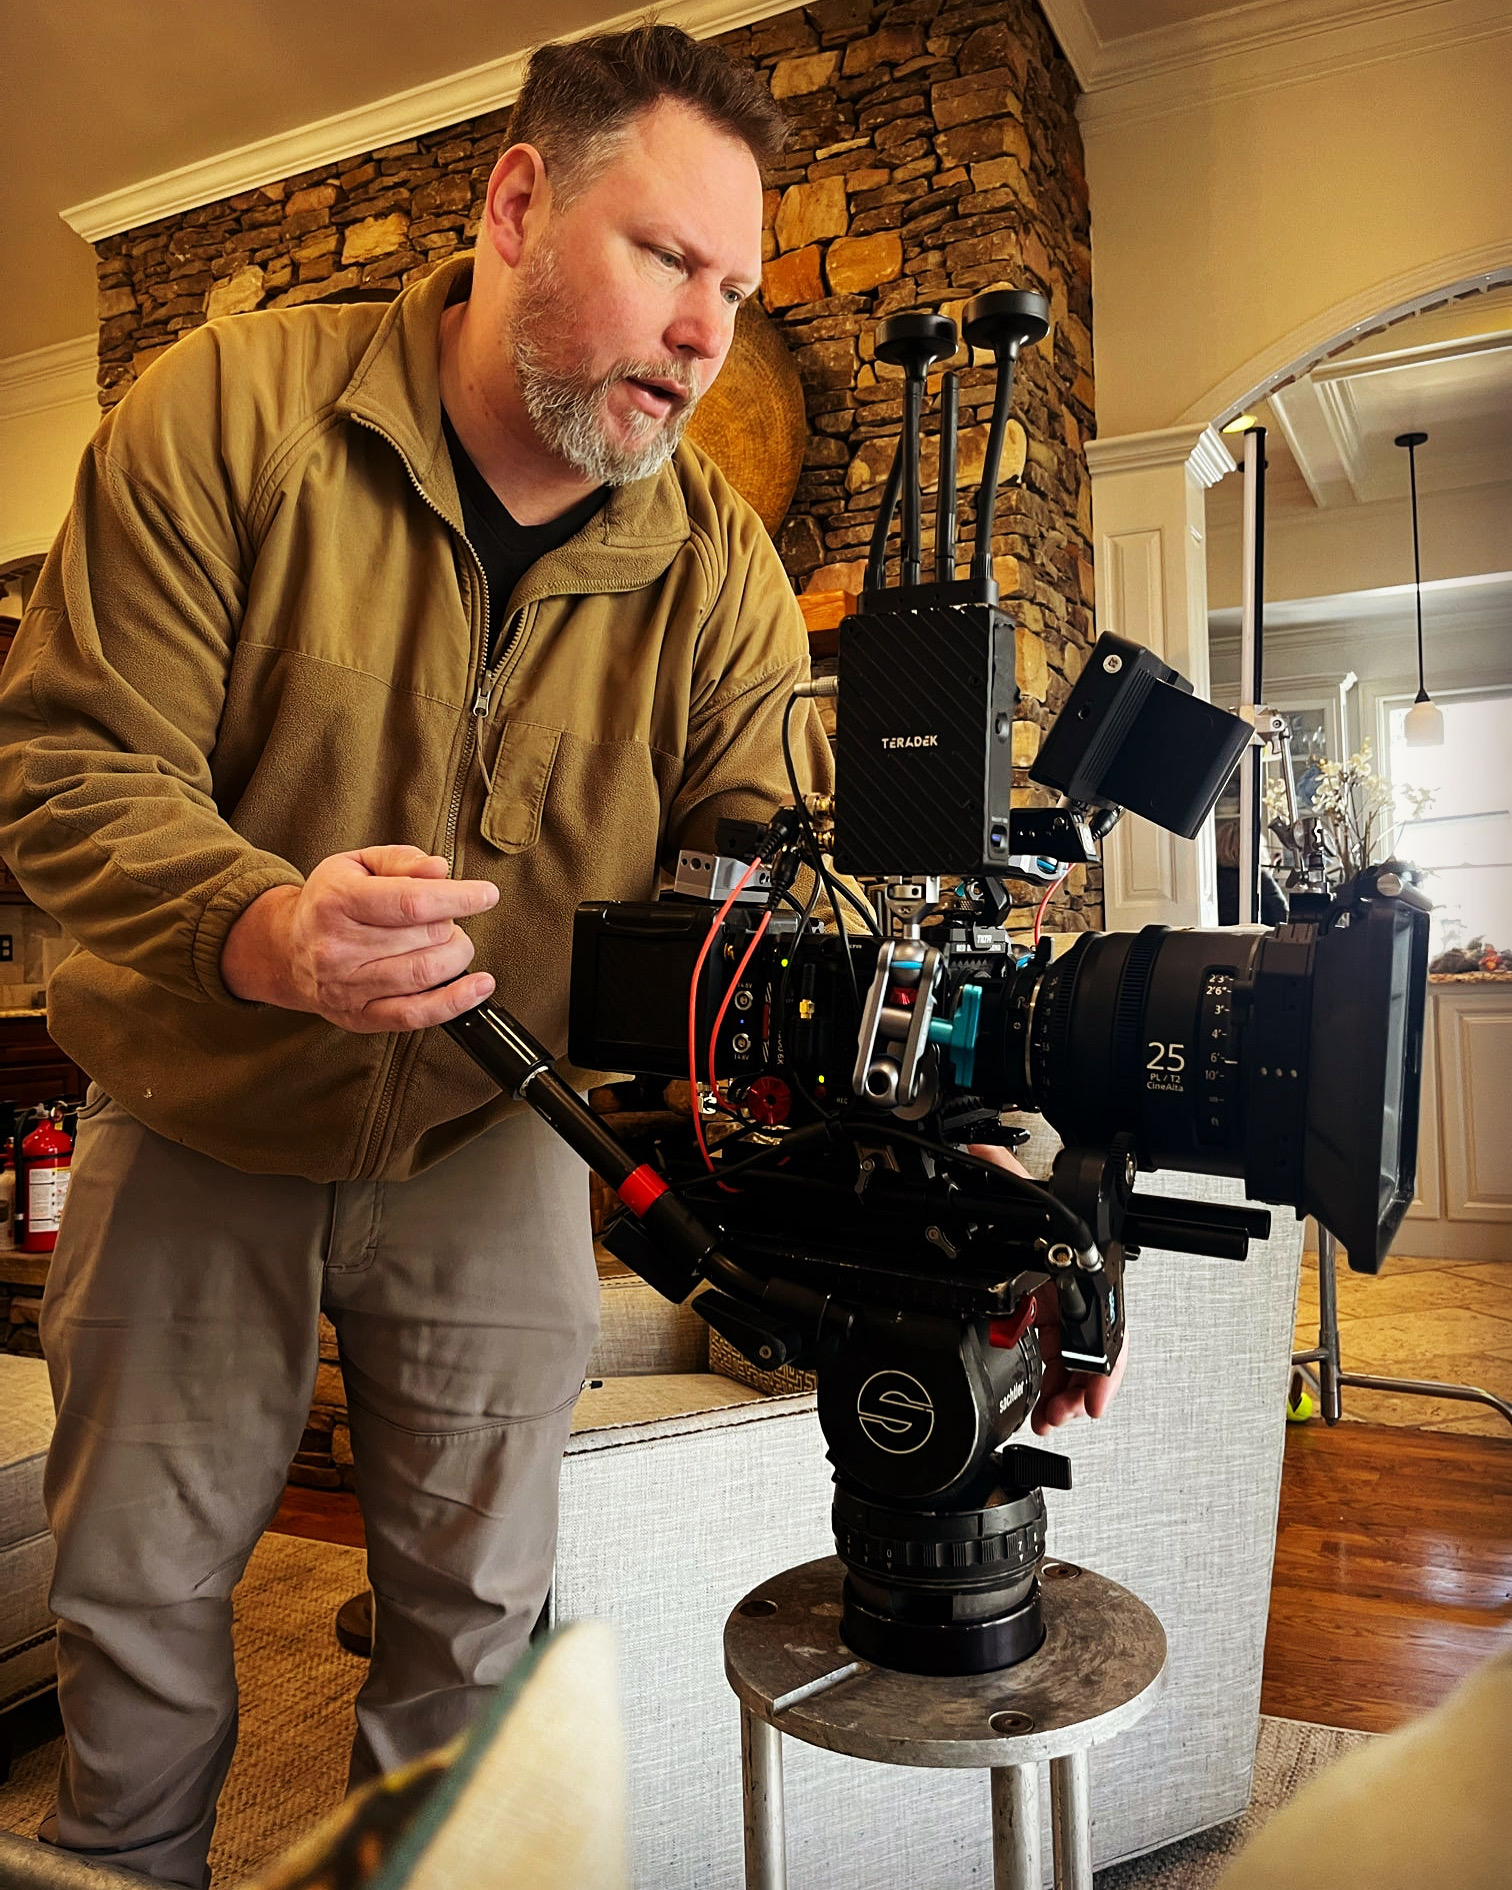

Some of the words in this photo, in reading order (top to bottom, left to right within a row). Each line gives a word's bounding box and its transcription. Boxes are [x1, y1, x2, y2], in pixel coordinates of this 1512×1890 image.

[881, 735, 938, 749] TERADEK
[1146, 1042, 1185, 1072] 25
[1146, 1081, 1184, 1092] CineAlta
[999, 1380, 1025, 1414] sachtler
